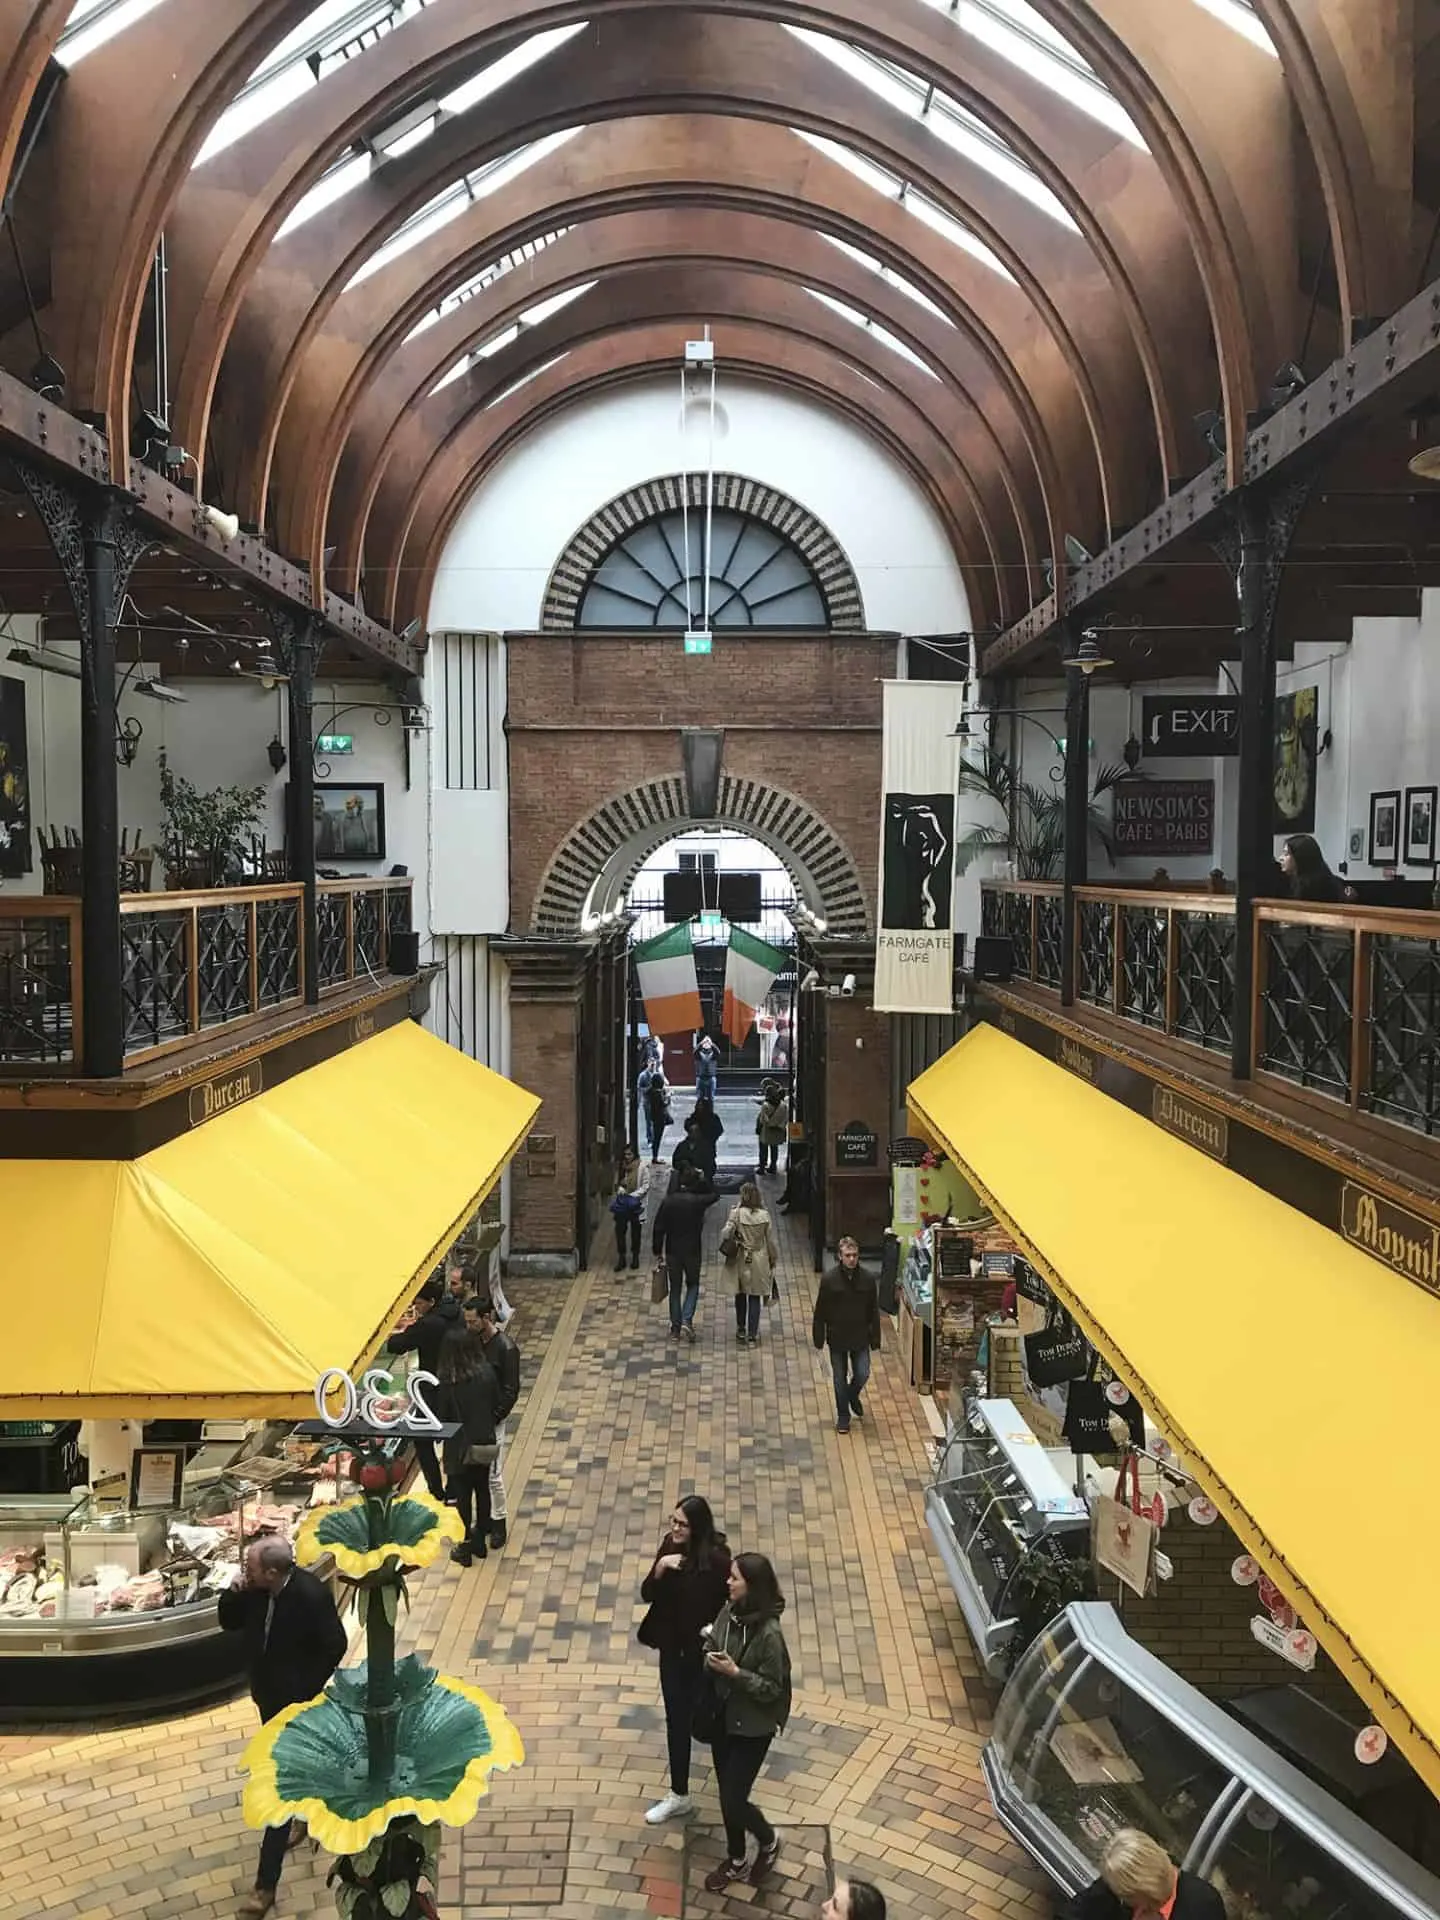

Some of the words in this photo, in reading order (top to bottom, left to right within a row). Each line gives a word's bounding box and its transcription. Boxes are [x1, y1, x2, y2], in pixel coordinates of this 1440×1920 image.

[1172, 709, 1235, 733] EXIT
[1115, 795, 1209, 820] NEWSOM'S
[1165, 822, 1209, 841] PARIS
[879, 935, 952, 950] FARMGATE
[202, 1073, 252, 1117] Durcan
[1159, 1088, 1219, 1148] Durcan
